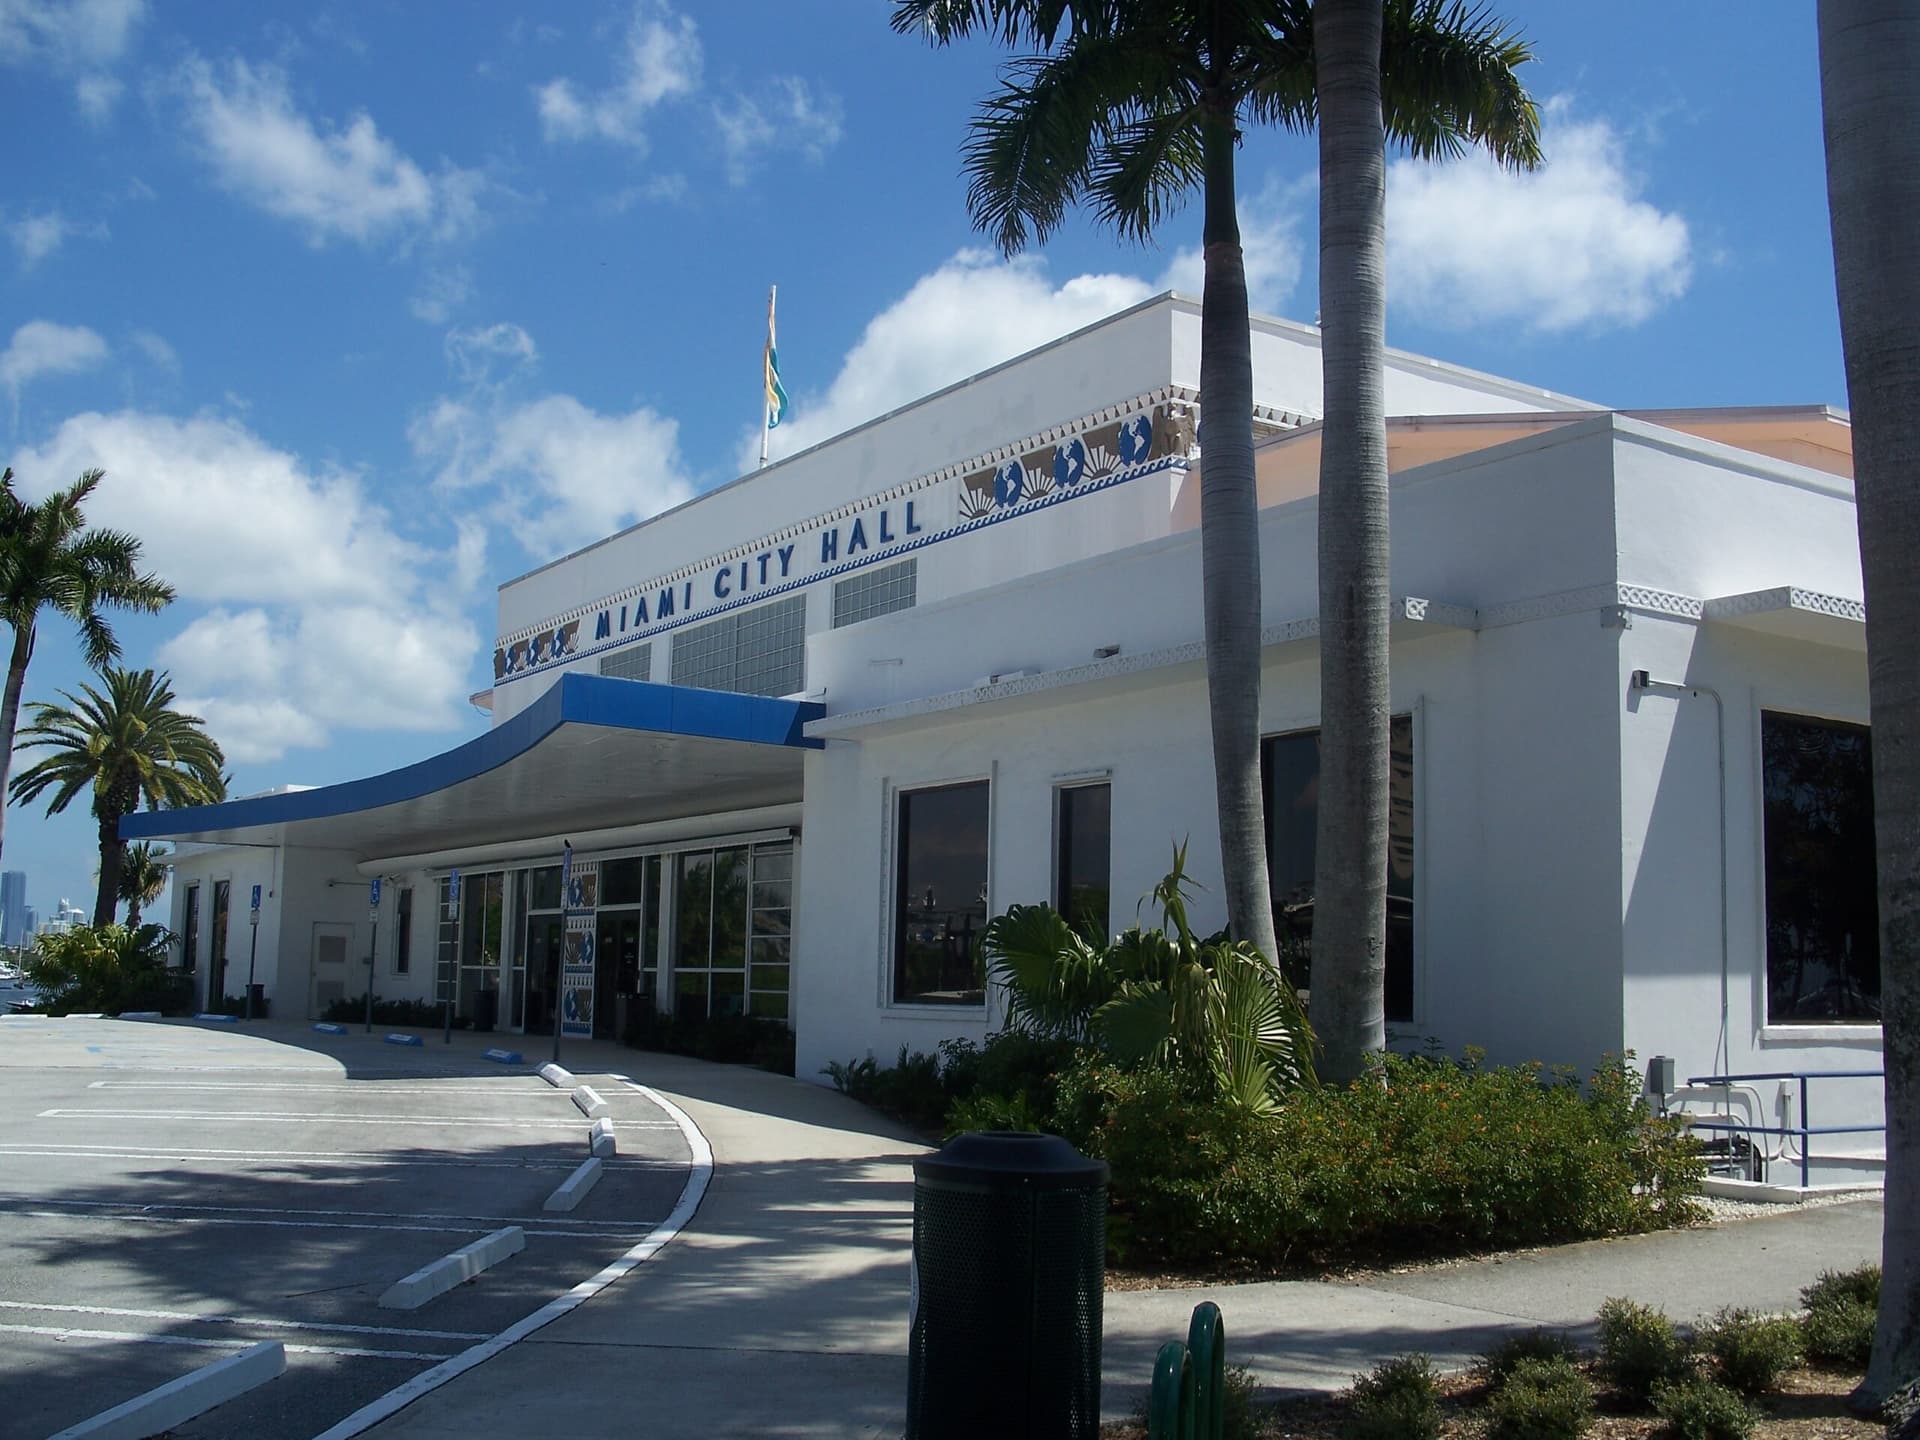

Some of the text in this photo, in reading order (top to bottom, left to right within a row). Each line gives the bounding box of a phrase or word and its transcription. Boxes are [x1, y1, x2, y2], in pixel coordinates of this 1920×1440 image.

[595, 501, 921, 640] MIAMI CITY HALL
